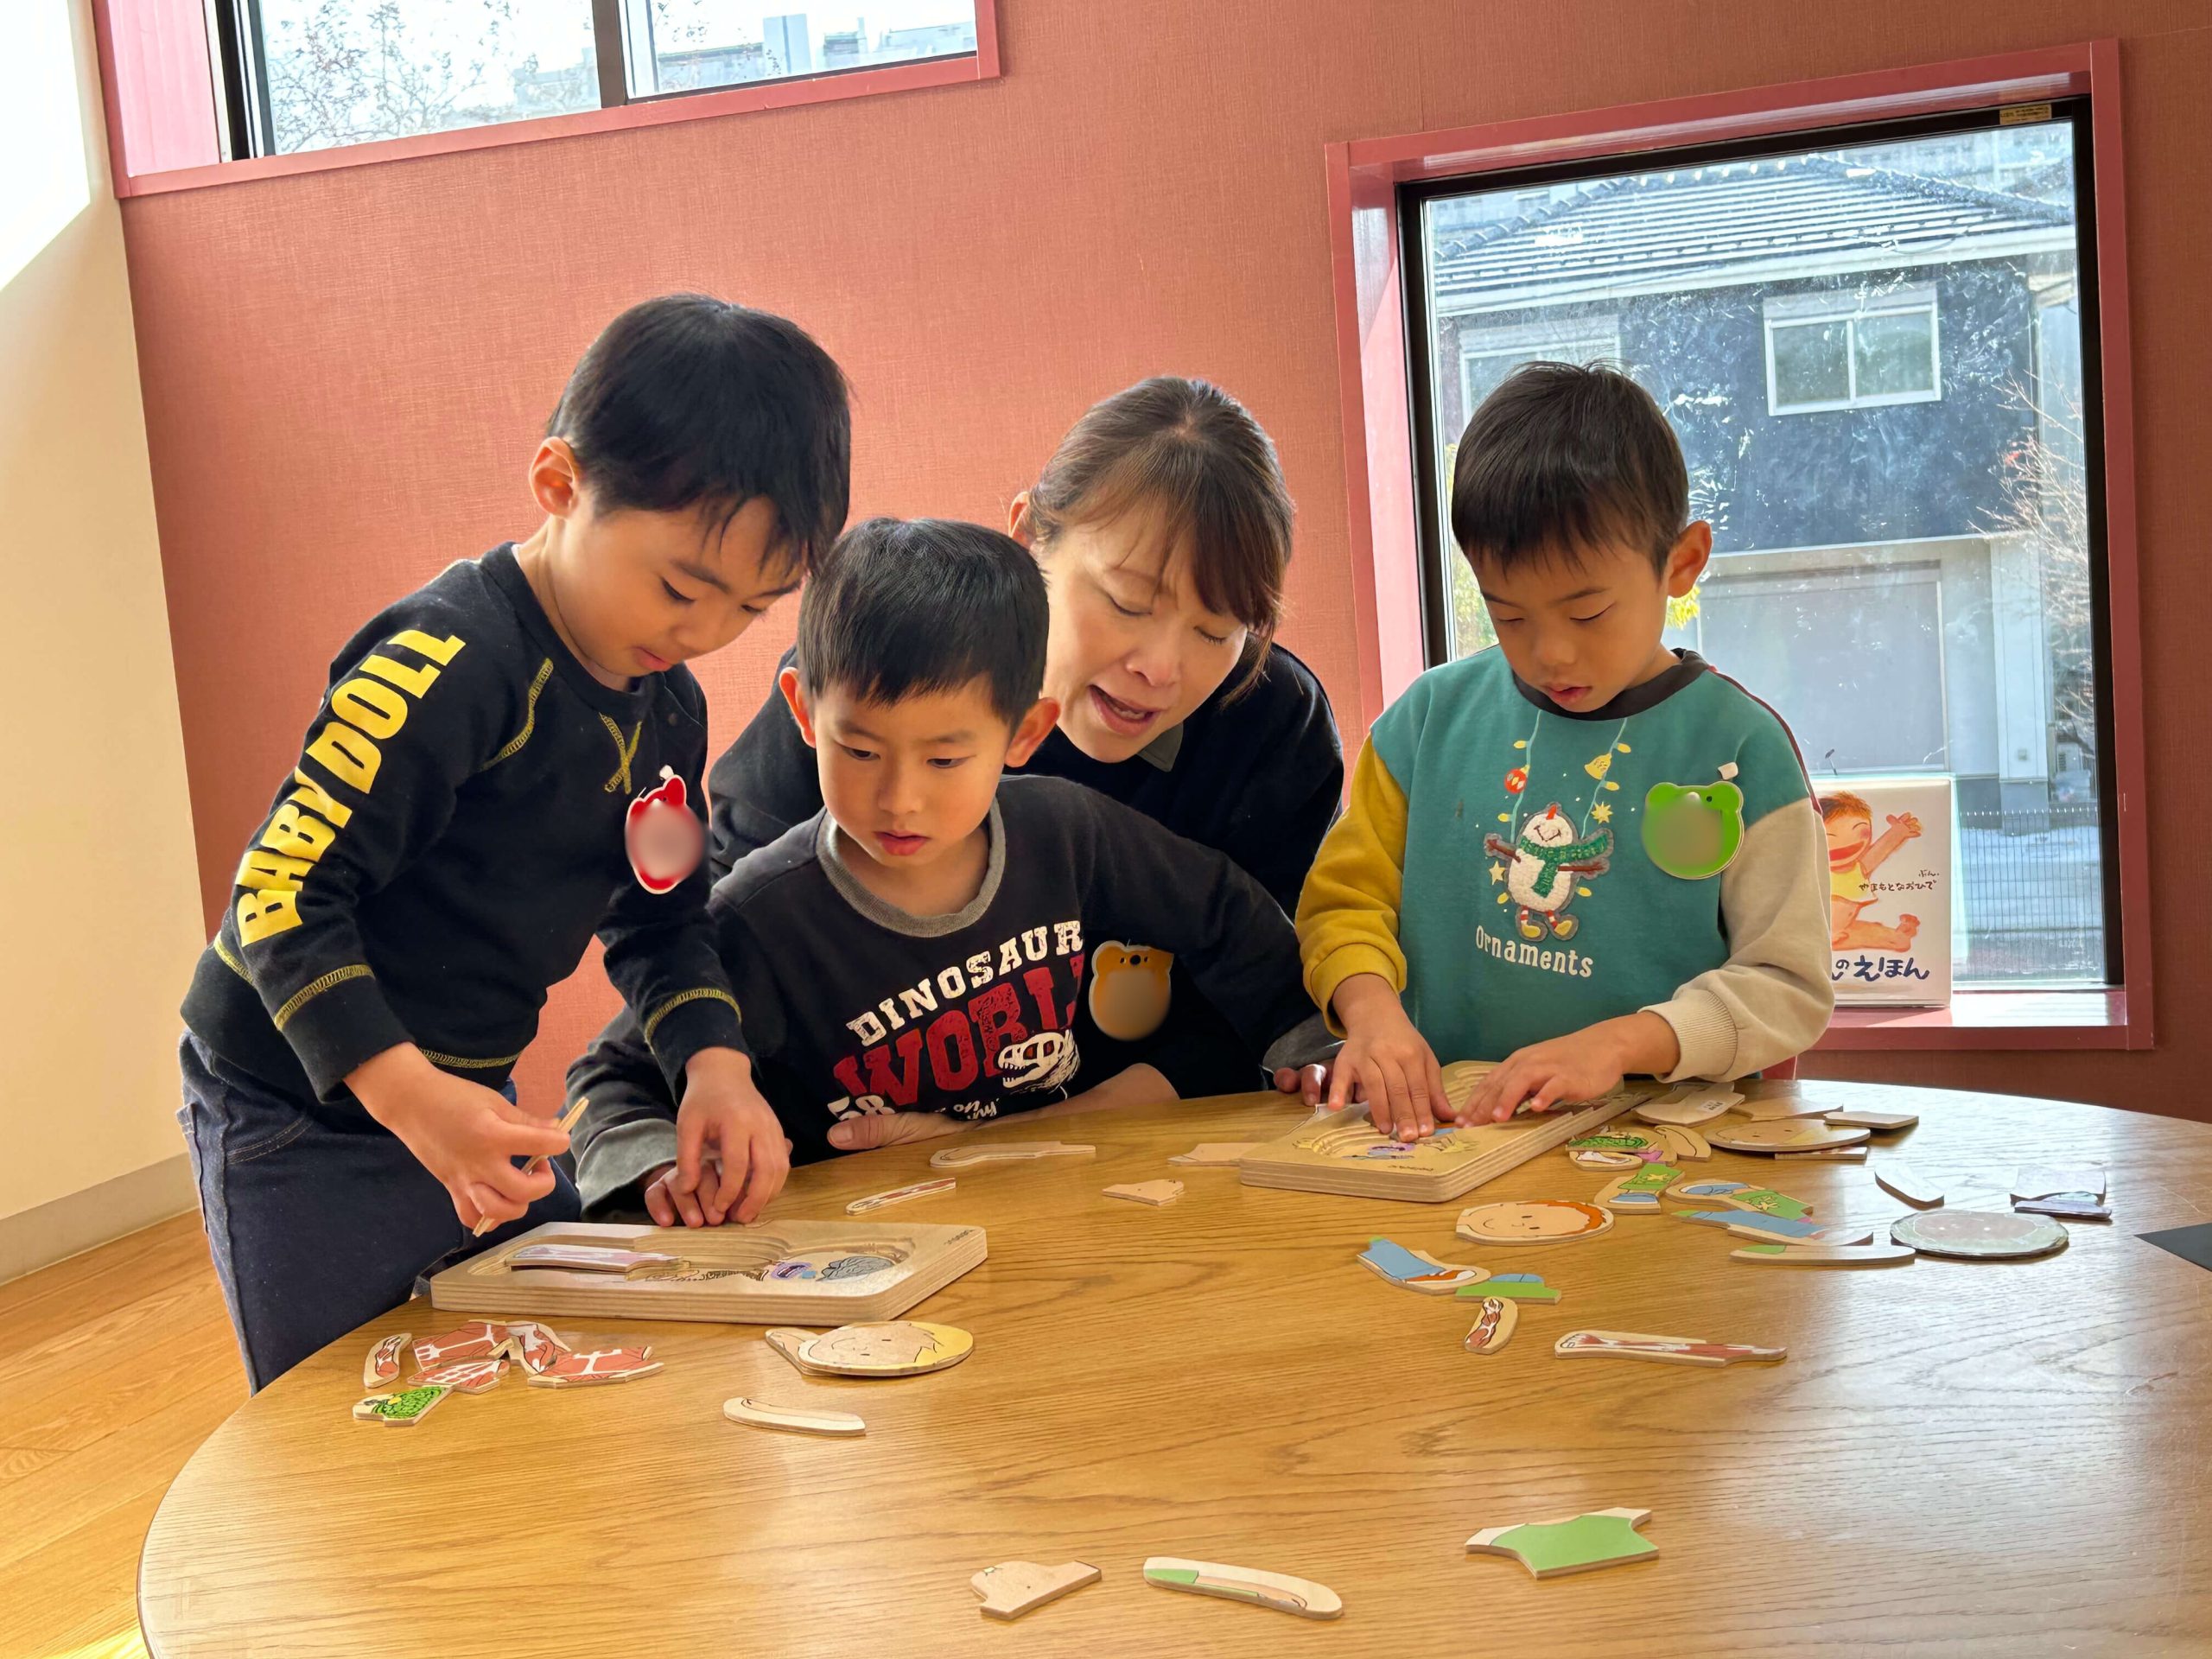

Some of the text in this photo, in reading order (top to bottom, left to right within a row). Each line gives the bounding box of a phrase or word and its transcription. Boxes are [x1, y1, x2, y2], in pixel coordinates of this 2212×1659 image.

[236, 628, 467, 948] BABY DOLL
[845, 919, 1084, 1047] DINOSAUR
[1475, 925, 1594, 978] Ornaments
[832, 953, 1085, 1107] WORL
